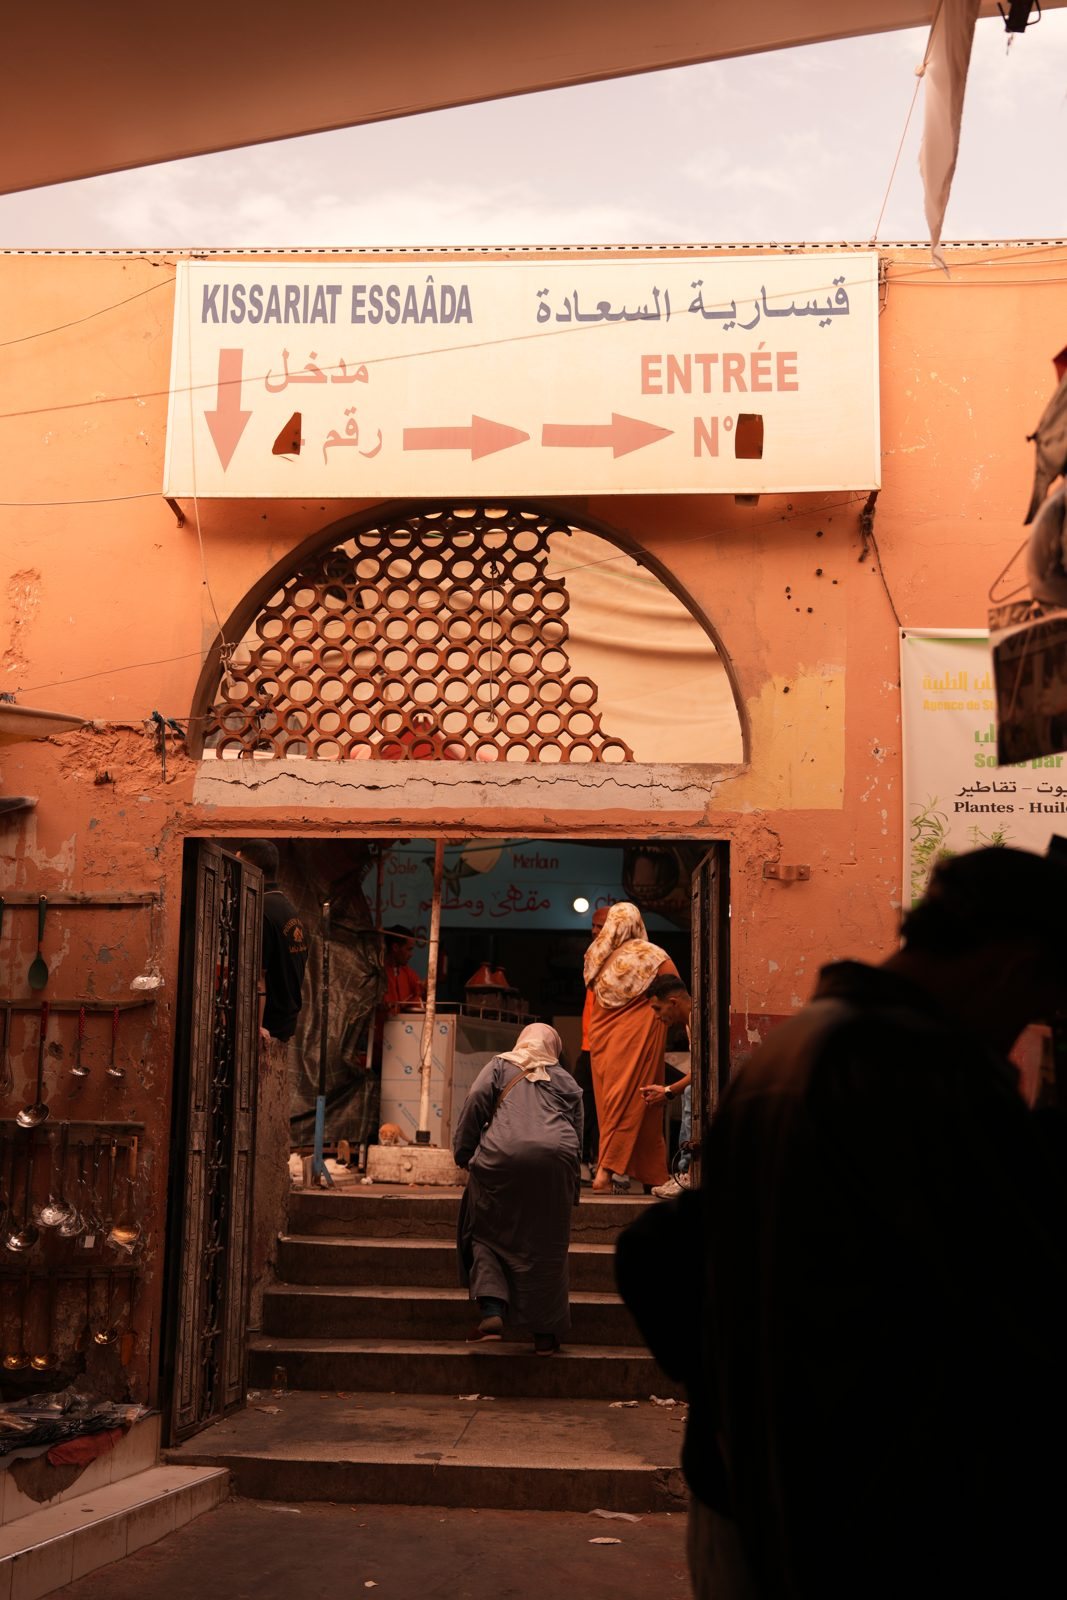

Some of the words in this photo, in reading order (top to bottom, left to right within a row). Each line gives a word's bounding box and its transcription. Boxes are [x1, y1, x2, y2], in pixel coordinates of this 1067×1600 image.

[201, 283, 342, 324] KISSARIAT
[350, 275, 473, 324] ESSAÂDA
[536, 285, 671, 323] السعادة
[688, 275, 850, 331] قيسارية
[264, 347, 369, 393] مدخل
[640, 341, 799, 395] ENTRÉE
[322, 406, 383, 465] رقم
[953, 801, 1014, 813] Plantes
[1029, 802, 1067, 813] Huil
[955, 780, 1017, 797] تقاطير
